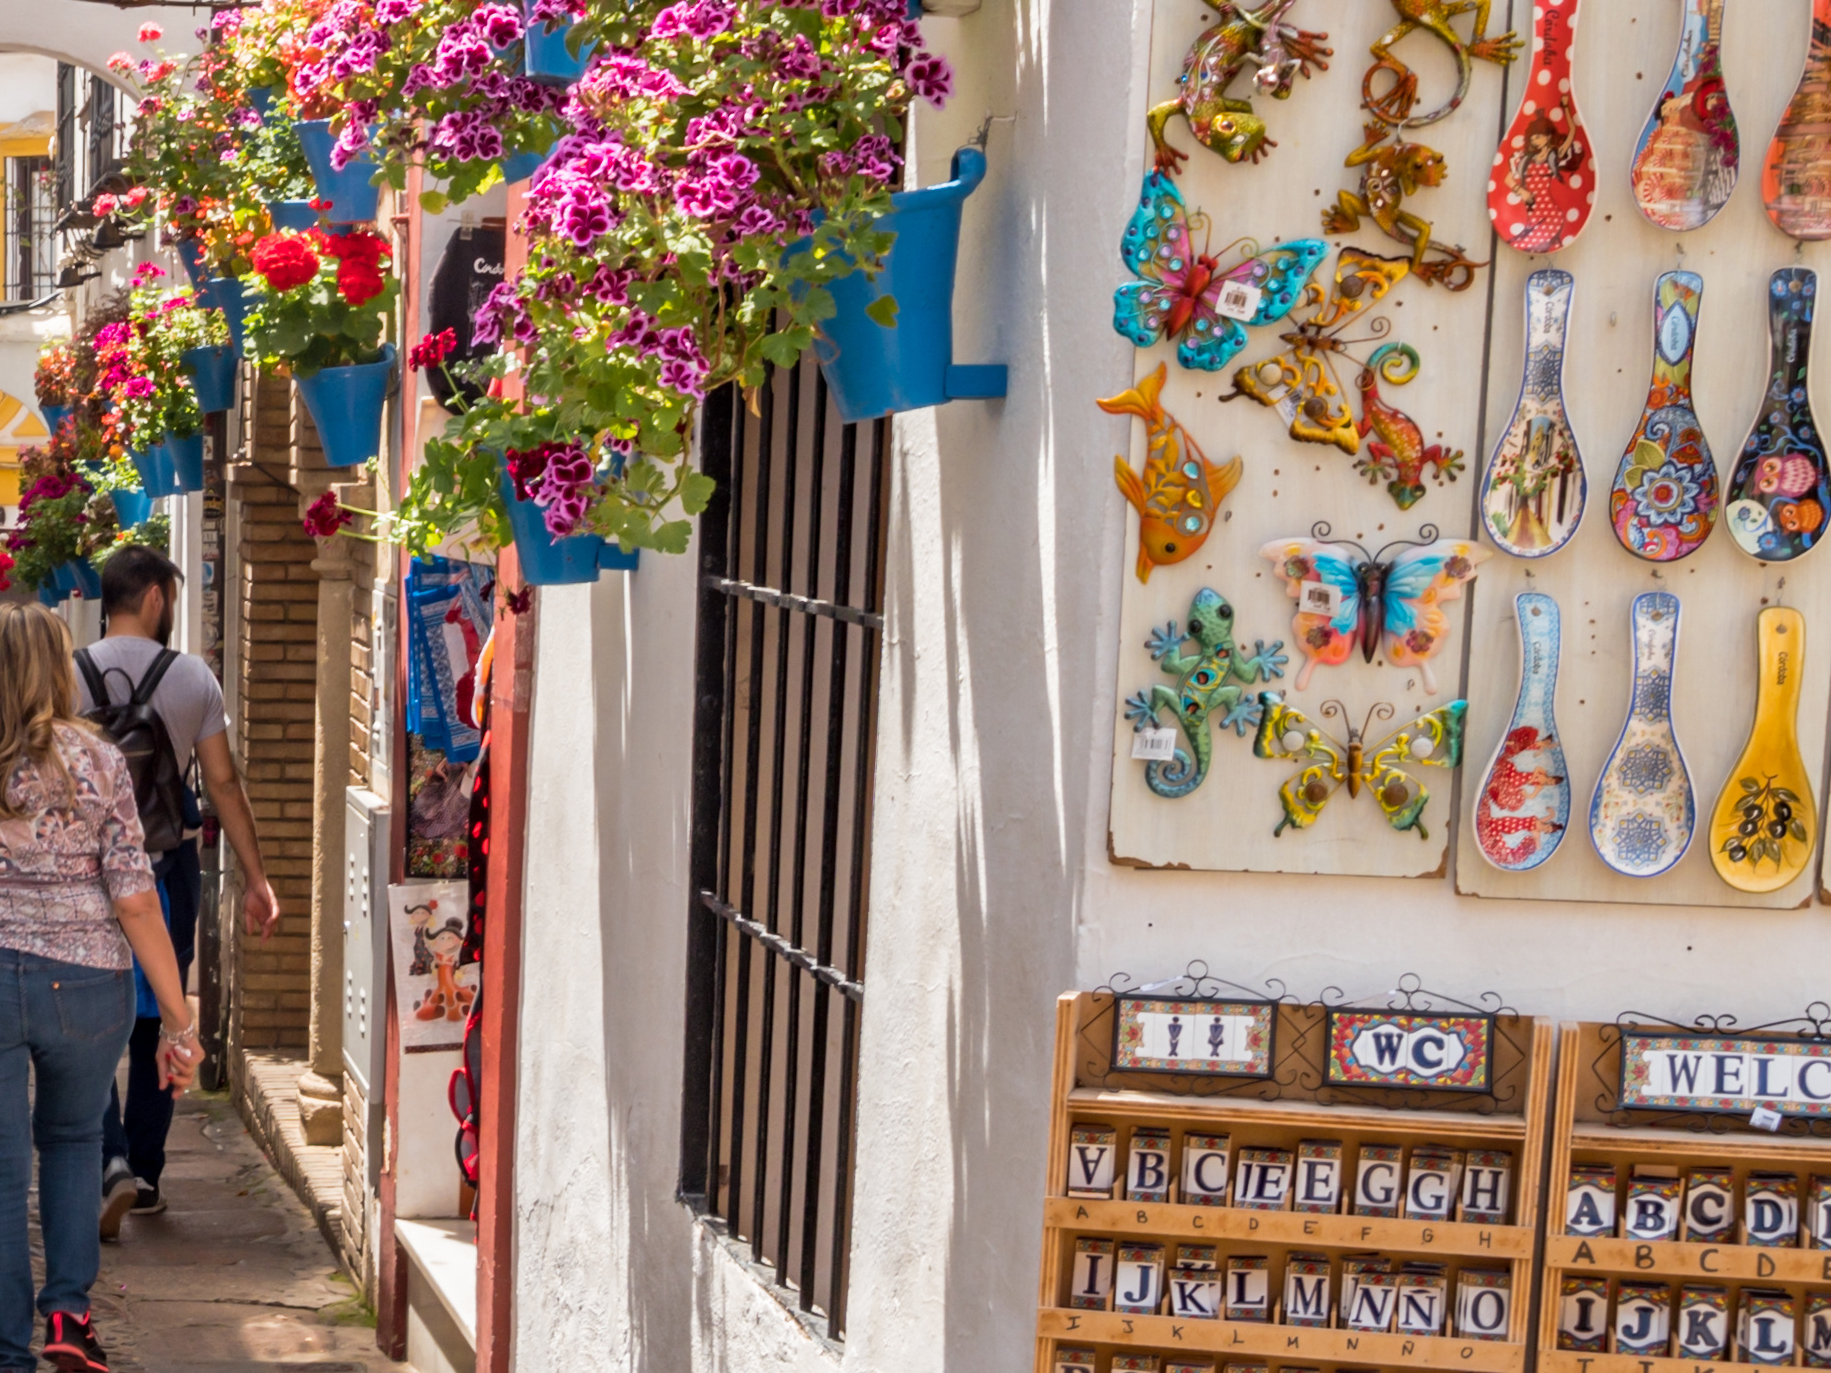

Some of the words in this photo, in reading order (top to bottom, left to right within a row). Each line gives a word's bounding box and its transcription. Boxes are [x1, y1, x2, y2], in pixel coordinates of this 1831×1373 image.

[1542, 9, 1560, 66] Córdoba
[1542, 301, 1555, 334] Córdoba
[1776, 651, 1789, 686] Córdoba
[1371, 1031, 1446, 1069] WC
[1666, 1053, 1831, 1101] WELC
[1134, 1151, 1165, 1189] B
[1194, 1152, 1226, 1193] C
[1301, 1160, 1334, 1202] E
[1361, 1163, 1395, 1204] G
[1411, 1172, 1445, 1211] G
[1465, 1168, 1504, 1211] H
[1075, 1205, 1089, 1219] A
[1136, 1211, 1148, 1223] B
[1192, 1216, 1204, 1229] C
[1249, 1218, 1259, 1231] D
[1303, 1221, 1318, 1234] E
[1361, 1227, 1372, 1241] F
[1422, 1228, 1434, 1243] G
[1479, 1231, 1491, 1248] H
[1569, 1191, 1604, 1227] A
[1631, 1199, 1666, 1231] B
[1690, 1191, 1726, 1227] C
[1751, 1199, 1784, 1233] D
[1571, 1240, 1596, 1264] A
[1635, 1245, 1655, 1269] B
[1699, 1248, 1719, 1273] C
[1757, 1253, 1776, 1277] D
[1082, 1254, 1103, 1295] I
[1123, 1265, 1154, 1303] J
[1174, 1281, 1209, 1313] K
[1231, 1271, 1265, 1305] L
[1290, 1276, 1326, 1317] M
[1351, 1287, 1392, 1325] N
[1402, 1289, 1437, 1327] Ñ
[1471, 1290, 1505, 1330] O
[1066, 1316, 1081, 1330] I
[1121, 1319, 1134, 1333] J
[1172, 1325, 1185, 1341] K
[1232, 1330, 1244, 1344] L
[1287, 1336, 1299, 1349] M
[1347, 1337, 1359, 1350] N
[1401, 1340, 1414, 1356] Ñ
[1574, 1297, 1596, 1332] I
[1621, 1306, 1655, 1340] J
[1684, 1310, 1719, 1347] K
[1754, 1317, 1787, 1353] L
